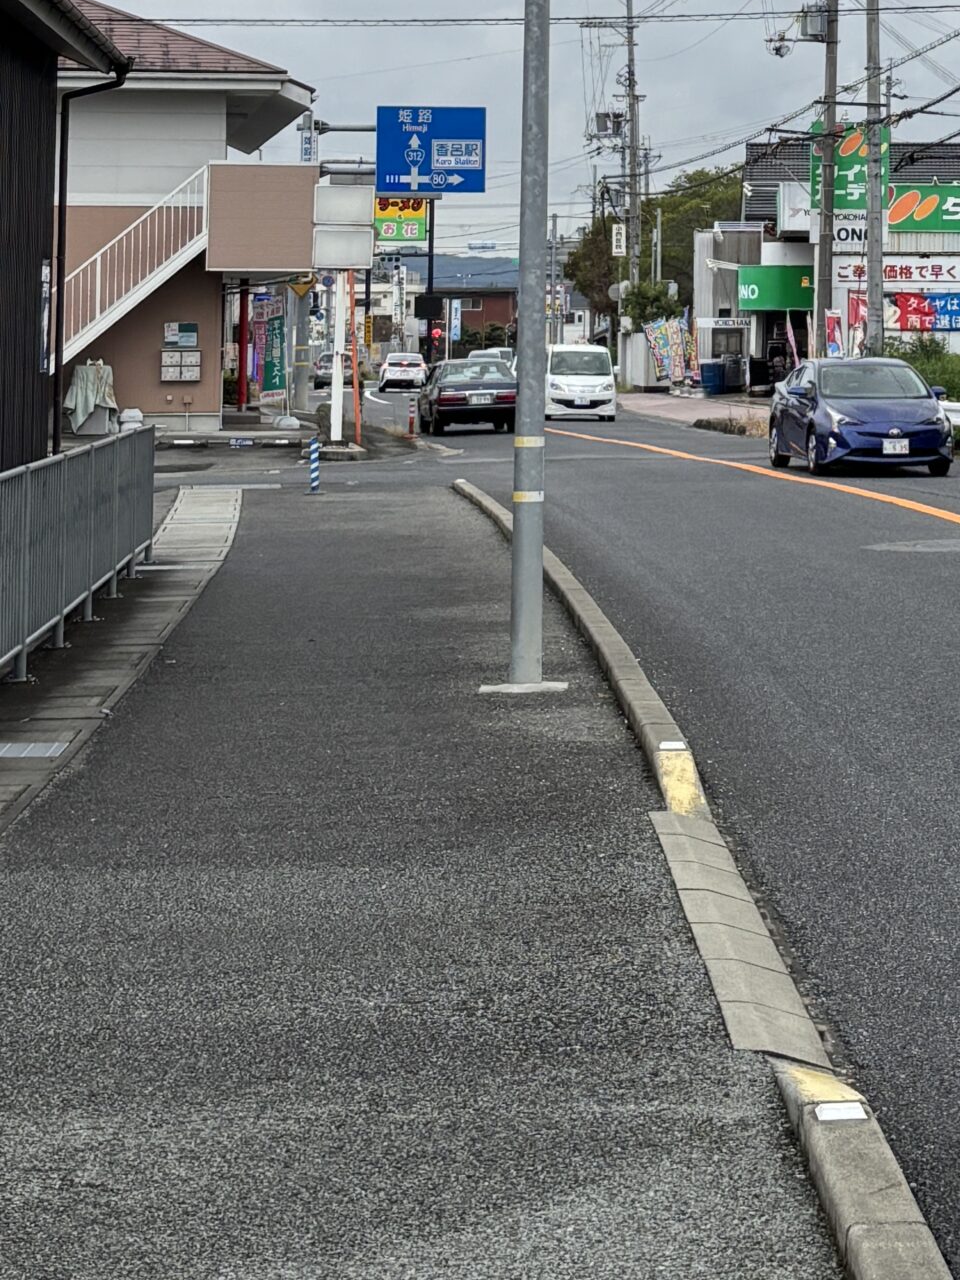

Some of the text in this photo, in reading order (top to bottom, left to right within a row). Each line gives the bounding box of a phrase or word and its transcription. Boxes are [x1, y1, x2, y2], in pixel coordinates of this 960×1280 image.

[398, 109, 432, 123] 姫路
[402, 124, 428, 133] Himeji
[436, 143, 479, 157] 香呂駅
[407, 151, 422, 161] 312
[454, 157, 479, 166] Station
[432, 174, 445, 184] 80
[382, 222, 418, 237] お花
